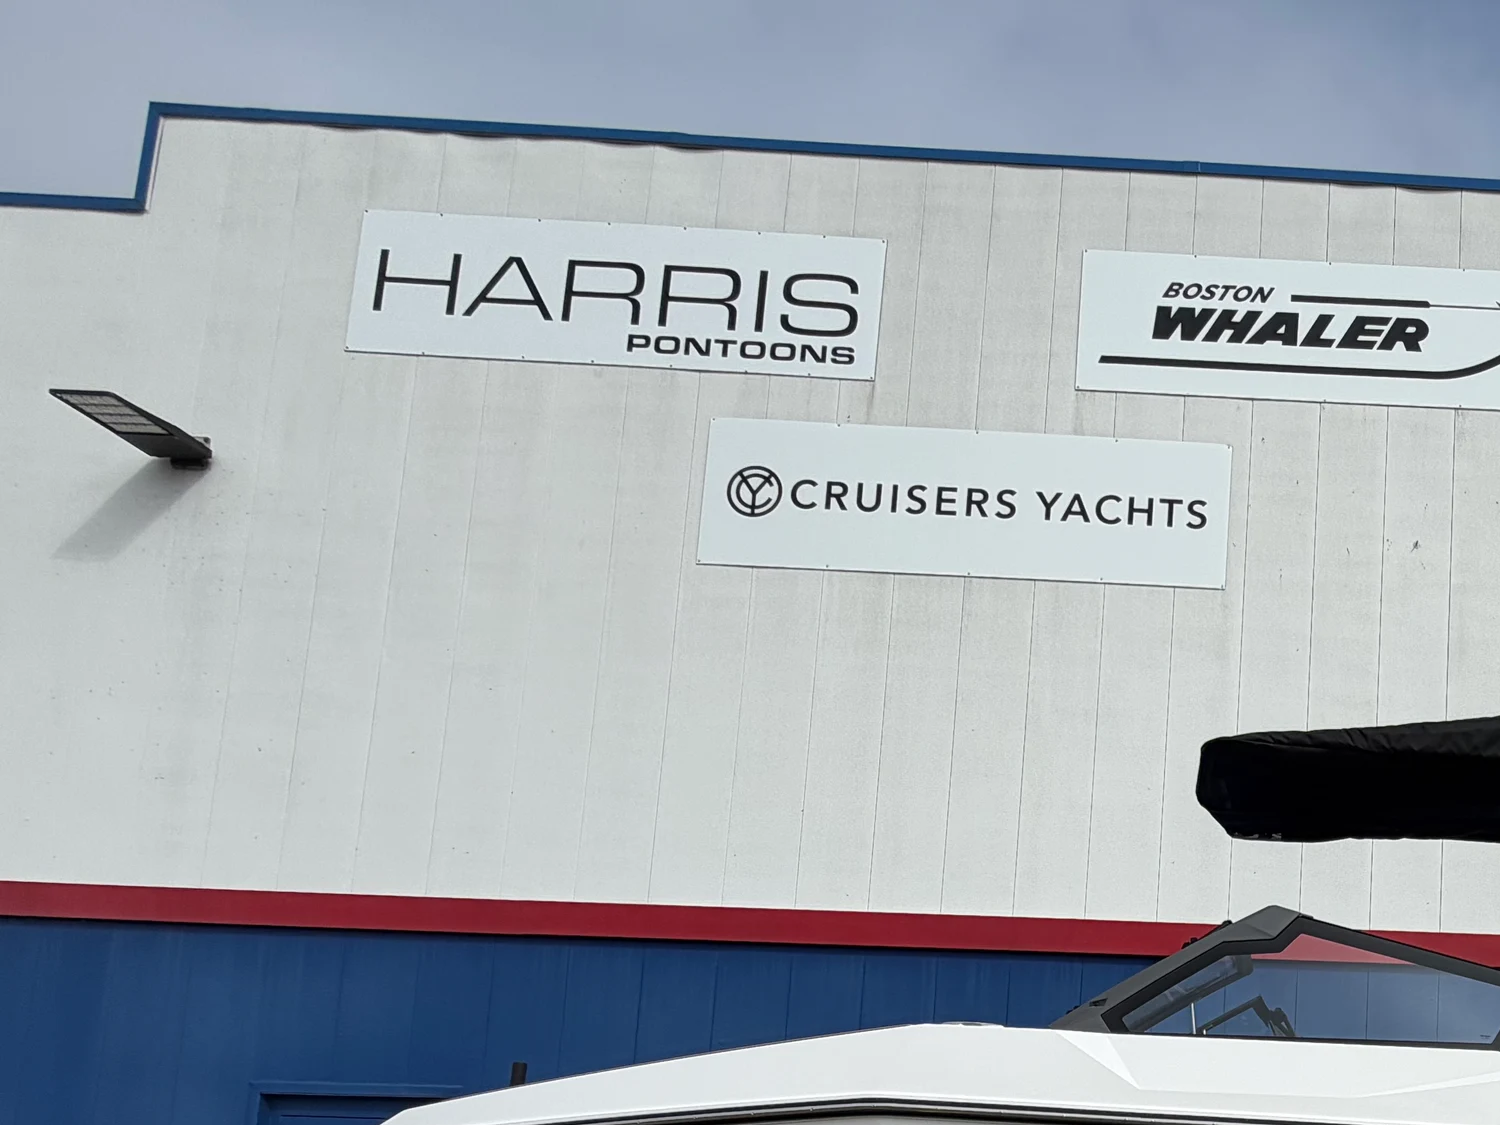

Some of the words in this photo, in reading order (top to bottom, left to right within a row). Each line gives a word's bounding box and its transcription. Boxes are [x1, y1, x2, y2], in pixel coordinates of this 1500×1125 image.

[372, 248, 860, 337] HARRIS
[1161, 281, 1276, 304] BOSTON
[625, 333, 856, 365] PONTOONS
[1151, 305, 1430, 353] WHALER
[790, 479, 1017, 520] CRUISERS
[1035, 491, 1208, 530] YACHTS
